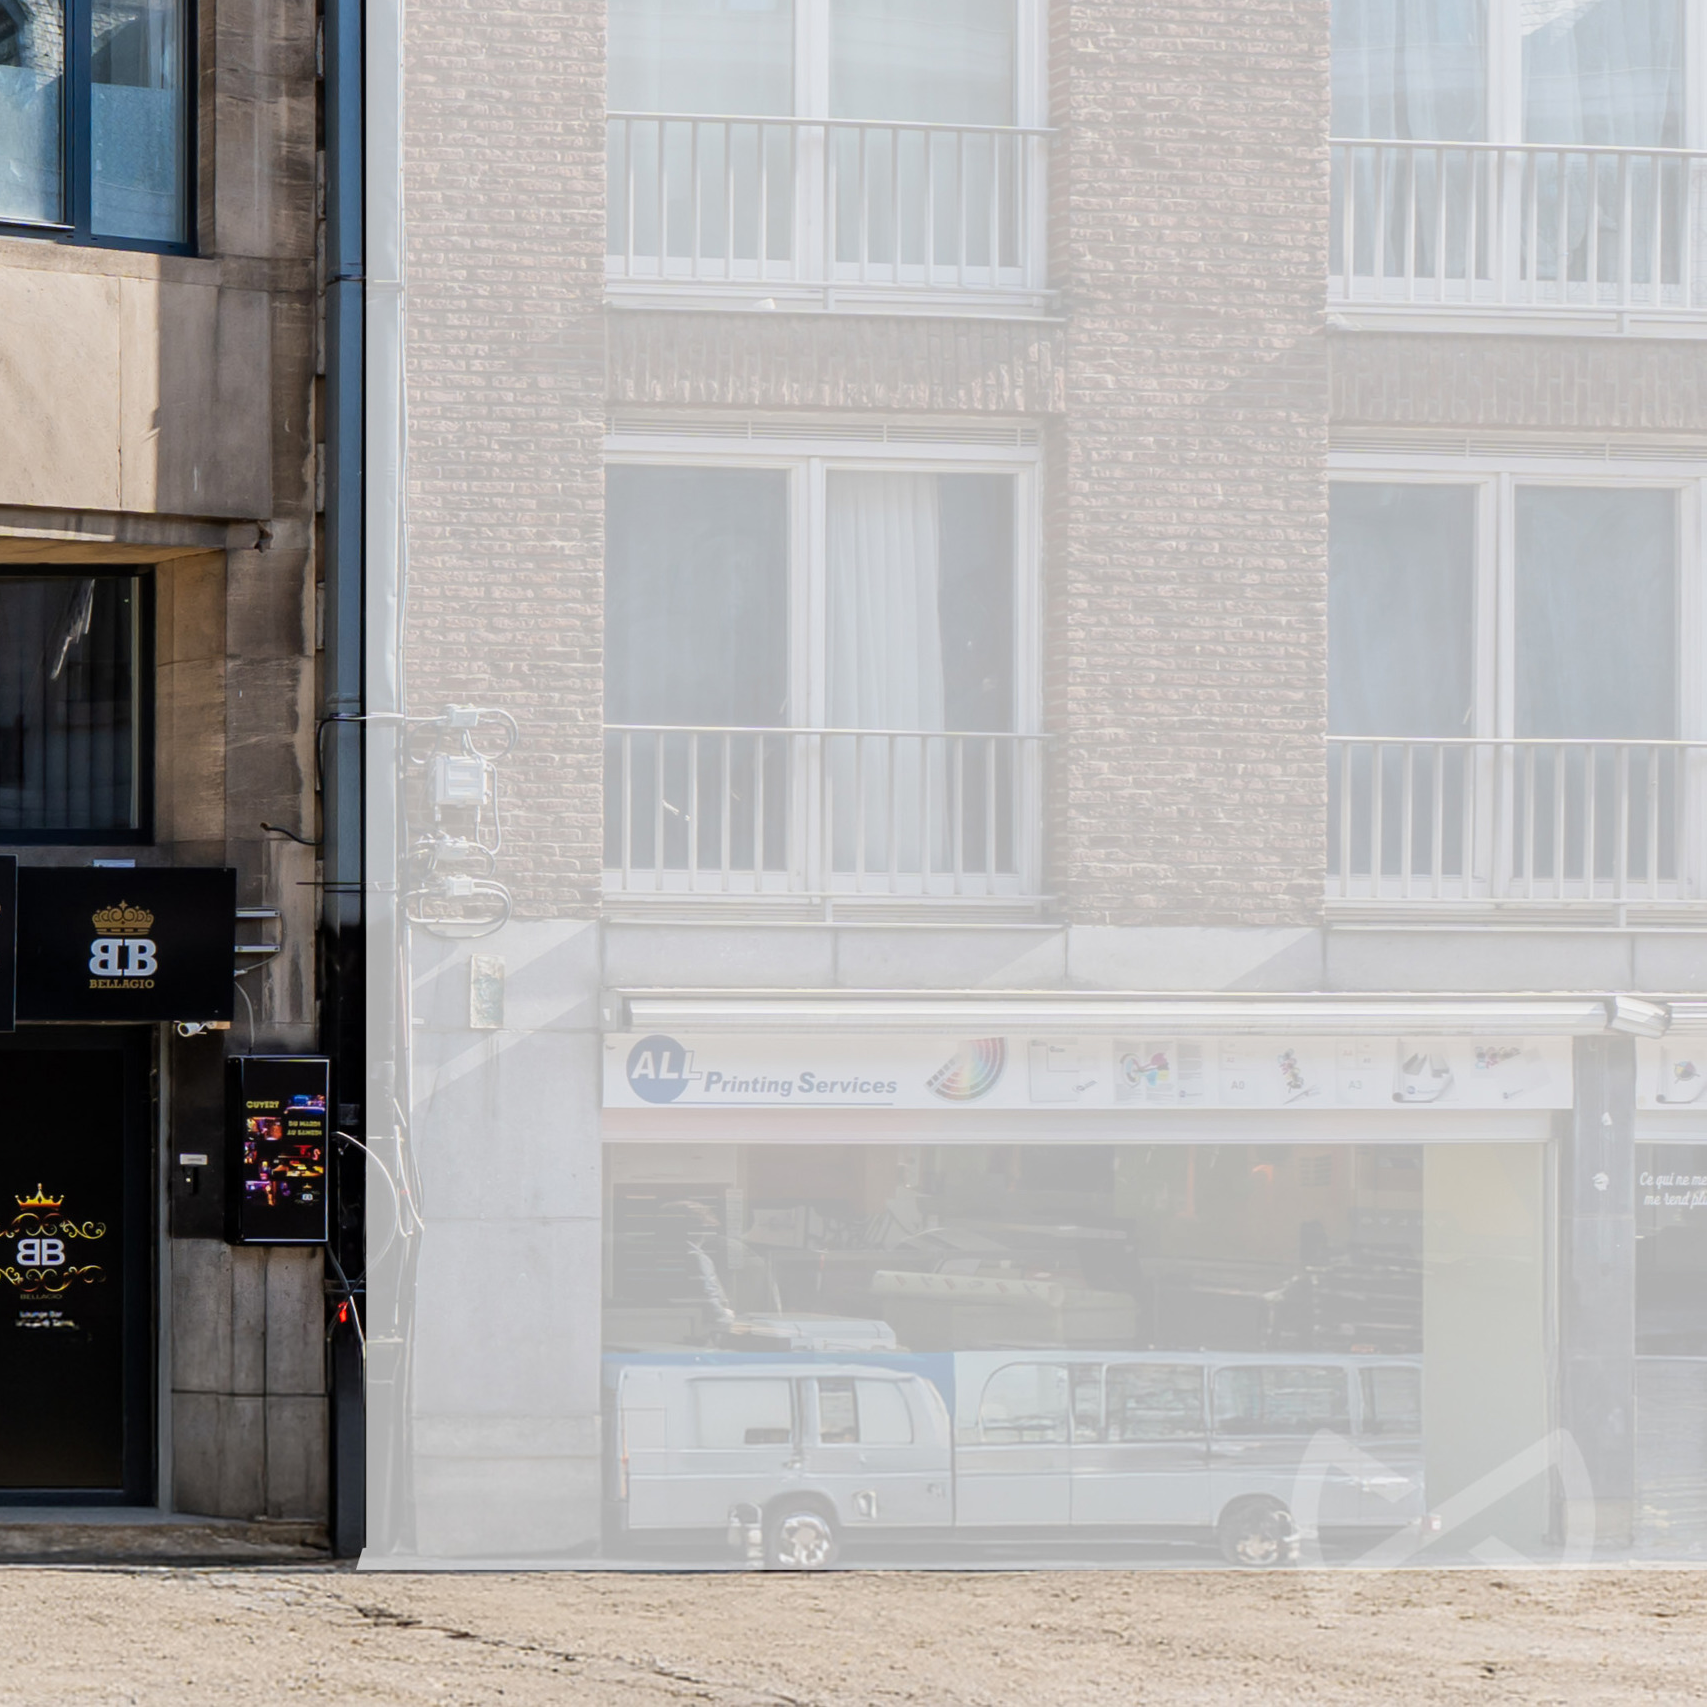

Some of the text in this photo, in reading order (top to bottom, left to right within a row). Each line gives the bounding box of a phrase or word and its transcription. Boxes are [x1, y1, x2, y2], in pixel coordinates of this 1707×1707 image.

[89, 979, 155, 990] BELLAGIO
[631, 1050, 898, 1097] ALL Printing Services
[245, 1099, 280, 1110] OUVERT
[1639, 1171, 1707, 1190] Ce qui ne me
[1643, 1194, 1661, 1206] me
